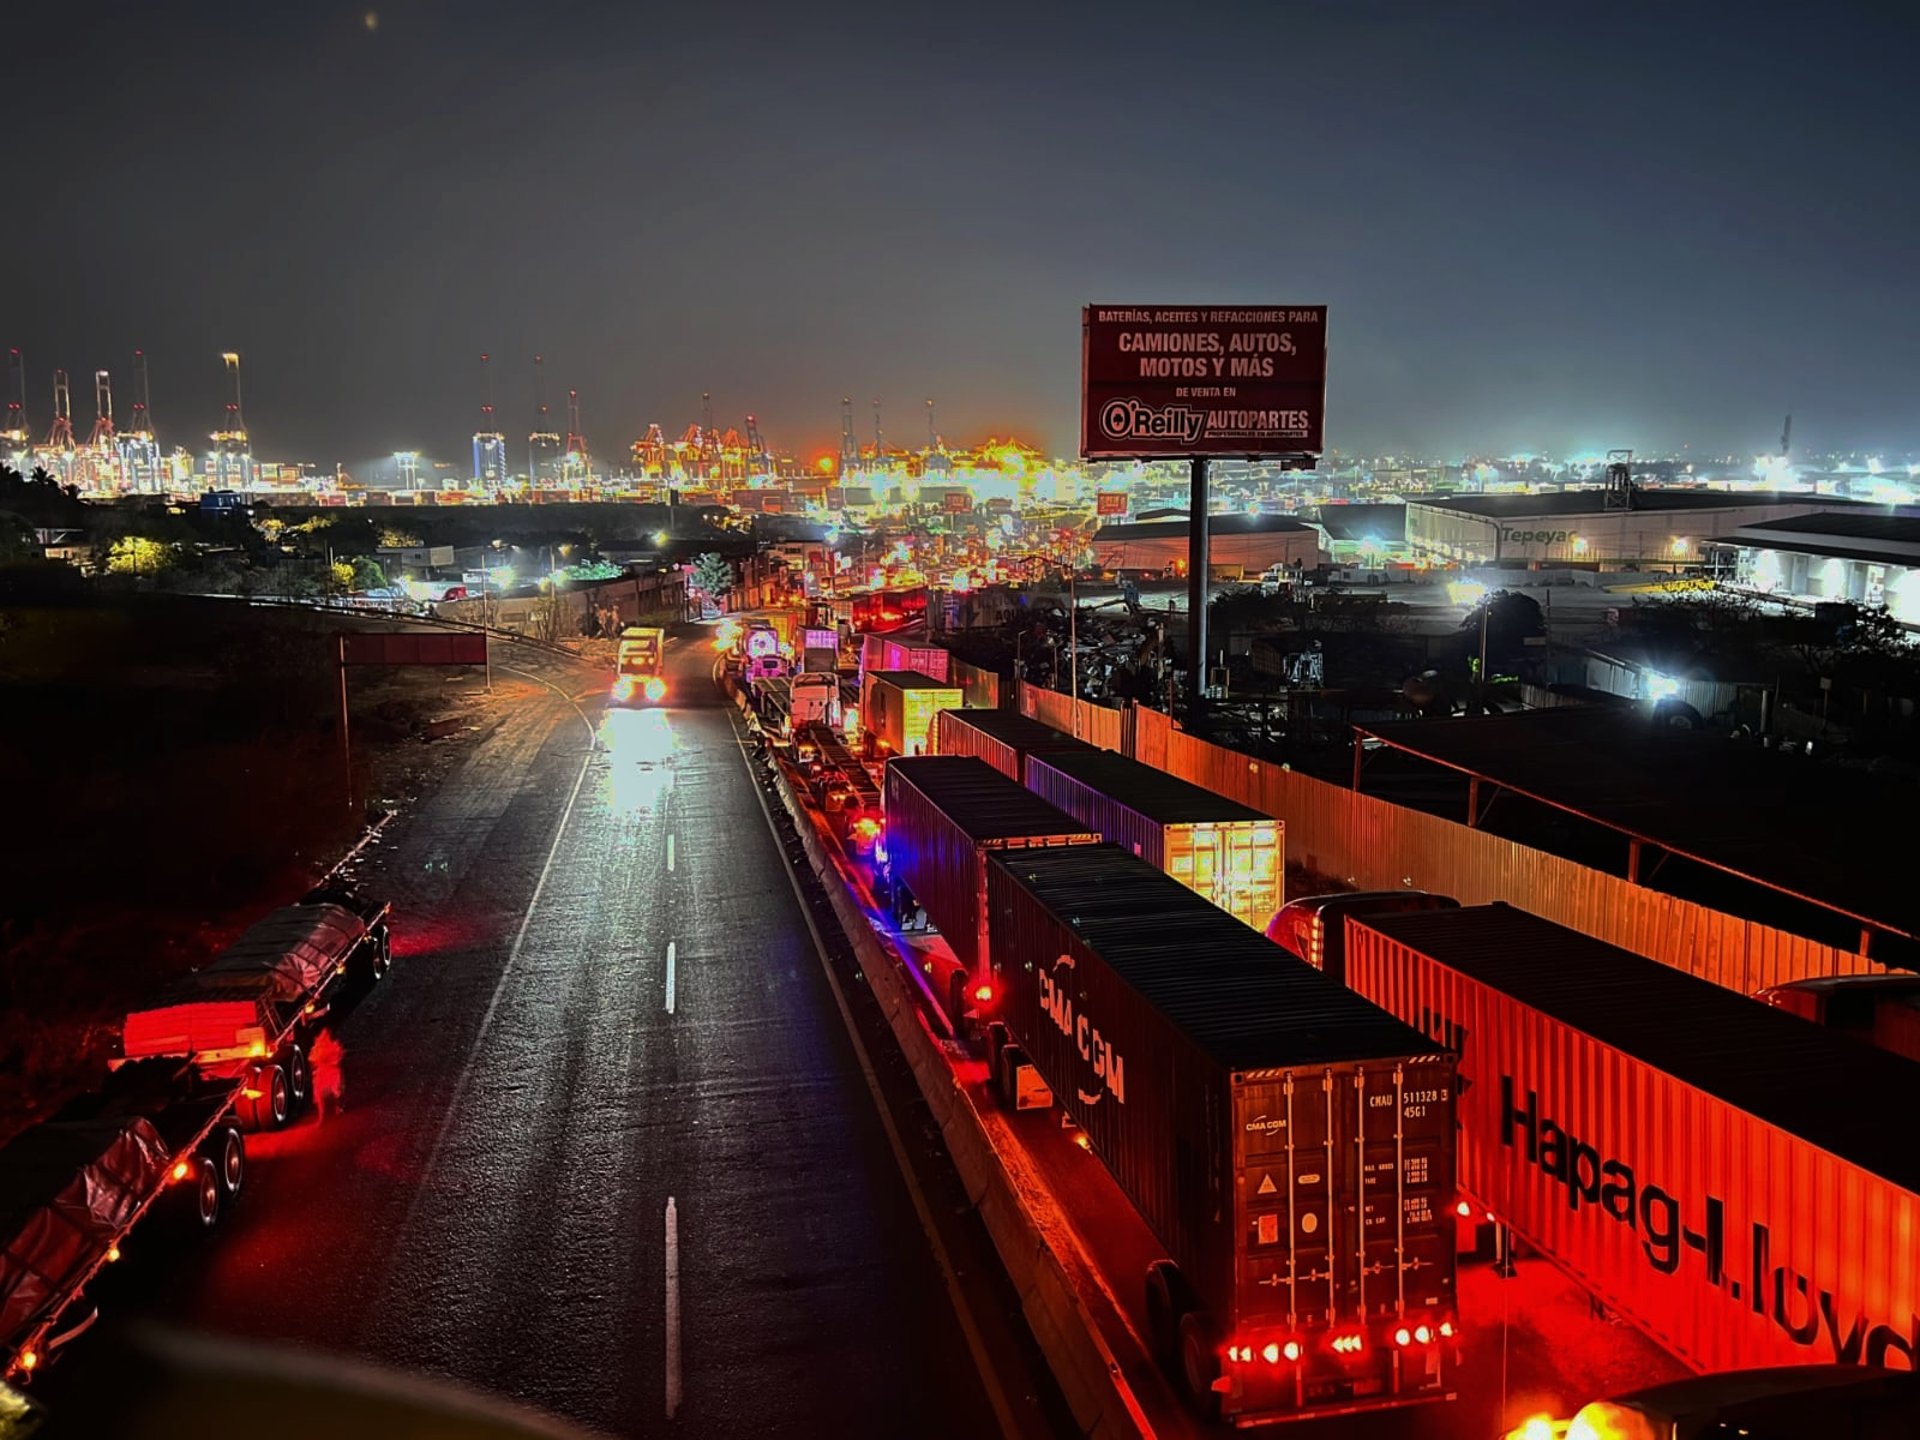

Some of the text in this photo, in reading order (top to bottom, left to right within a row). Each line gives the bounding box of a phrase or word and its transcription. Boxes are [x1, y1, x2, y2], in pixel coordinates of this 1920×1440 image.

[1098, 309, 1318, 325] BATERÍAS, ACEITES Y REFACCIONES PARA
[1119, 332, 1296, 356] CAMIONES, AUTOS,
[1140, 353, 1274, 377] MOTOS Y MÁS
[1176, 387, 1236, 398] DE VENTA EN
[1103, 400, 1309, 442] O'Reilly AUTOPARTES
[1038, 967, 1125, 1104] CMA CGM
[1403, 1089, 1438, 1105] 511328
[1245, 1122, 1266, 1131] CMA
